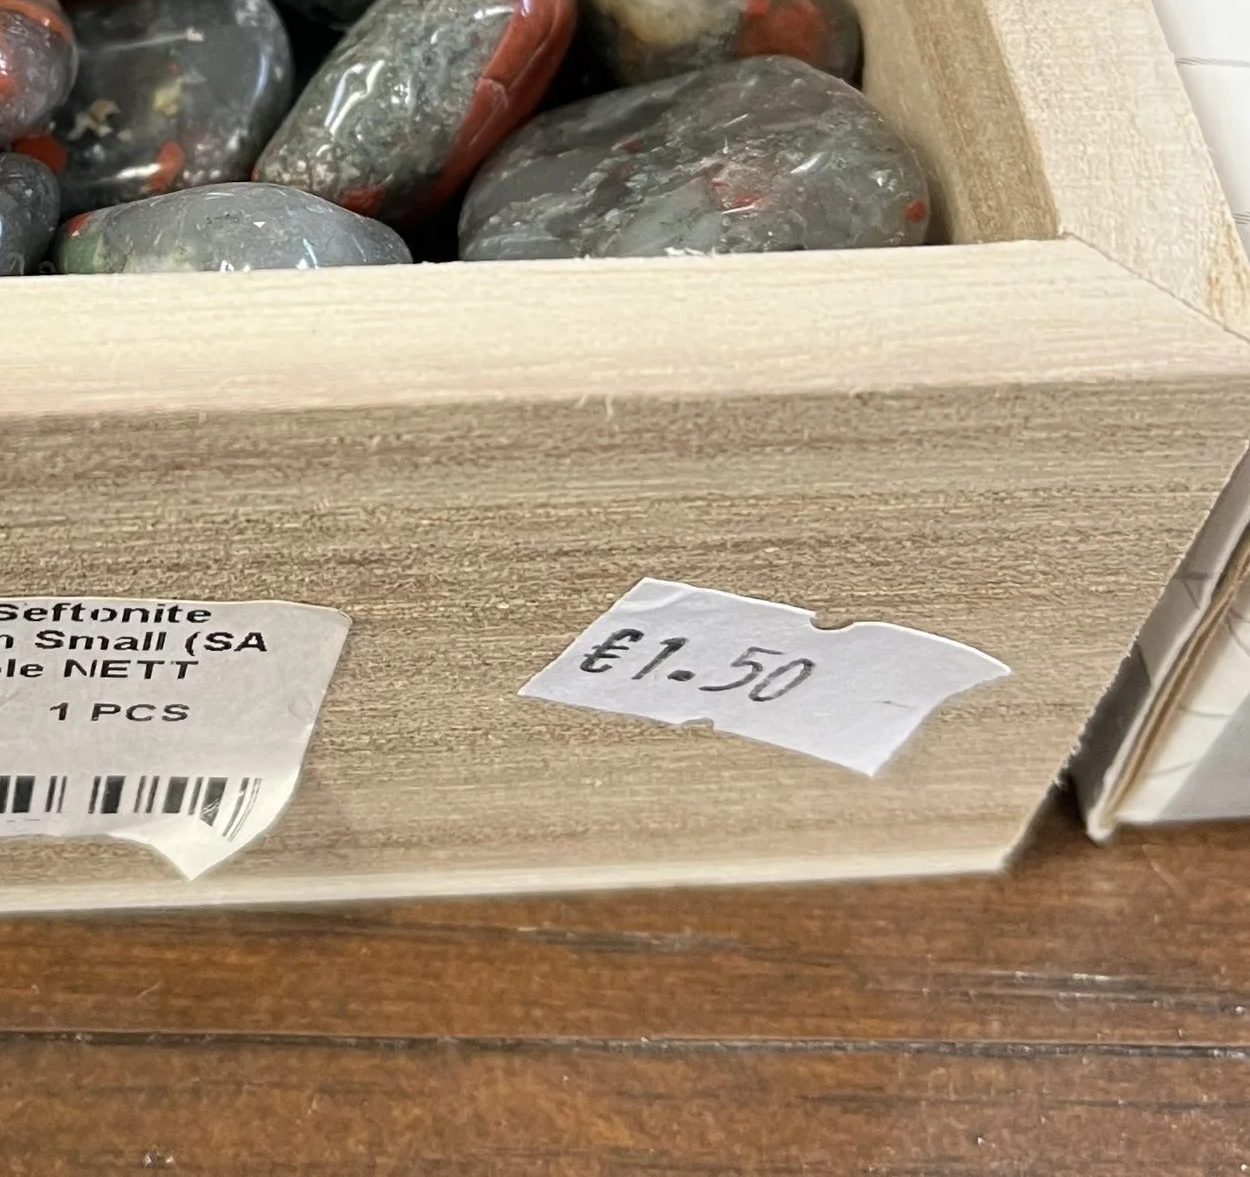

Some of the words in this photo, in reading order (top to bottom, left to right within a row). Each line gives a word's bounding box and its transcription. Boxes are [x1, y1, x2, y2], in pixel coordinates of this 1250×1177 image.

[34, 629, 165, 652] Small
[184, 631, 268, 655] (SA
[63, 659, 199, 680] NETT
[579, 628, 816, 701] €1.50
[49, 702, 68, 720] 1
[90, 703, 190, 722] PCS
